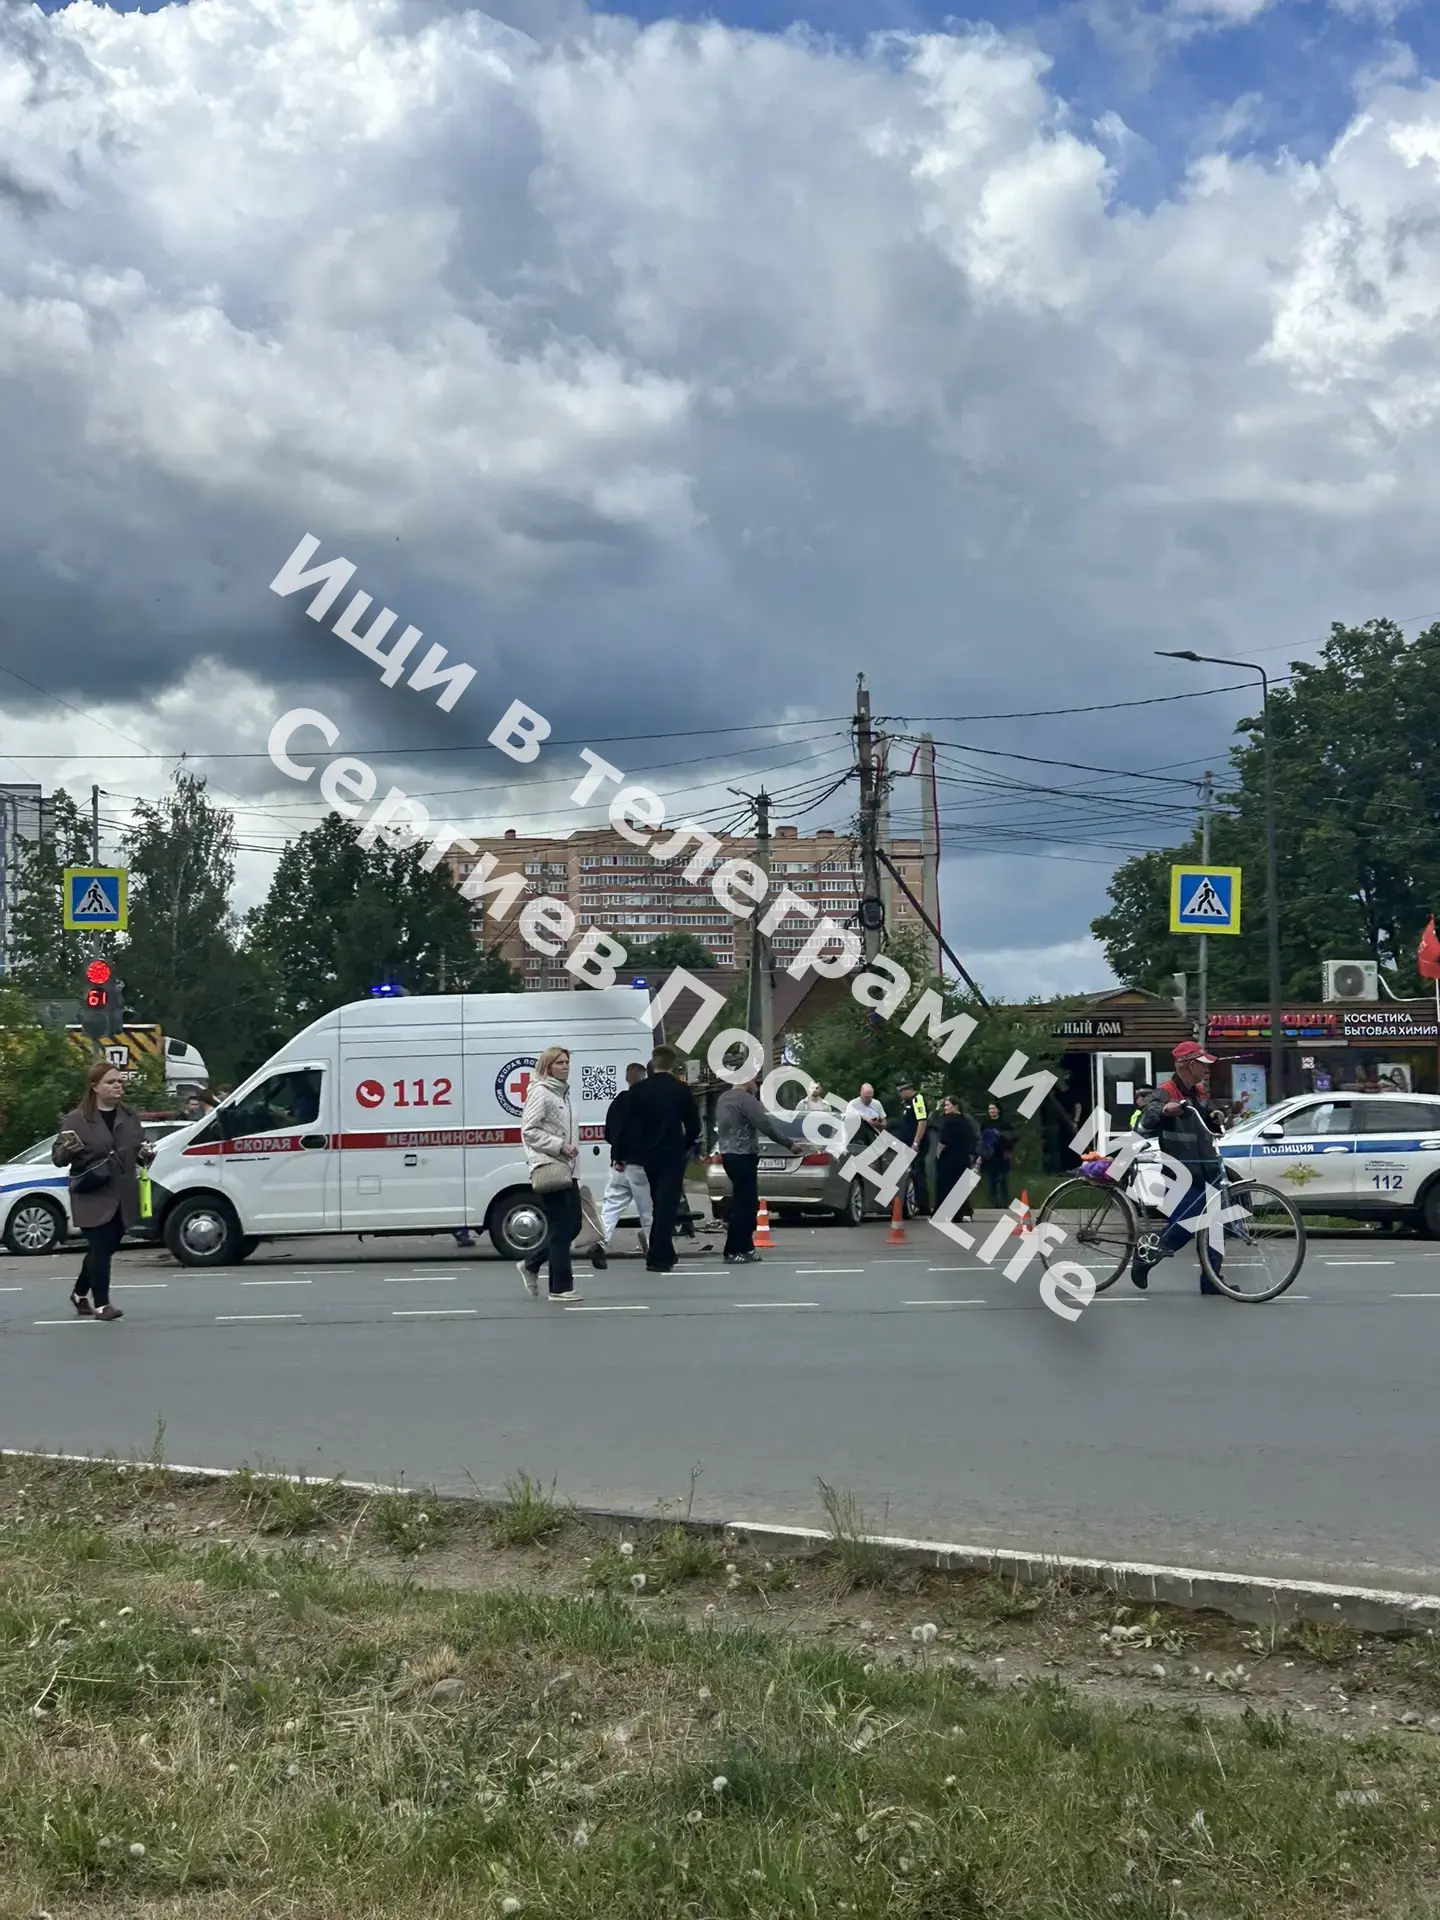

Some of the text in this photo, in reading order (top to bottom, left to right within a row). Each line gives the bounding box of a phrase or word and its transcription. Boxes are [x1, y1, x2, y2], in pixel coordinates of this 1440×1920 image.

[88, 990, 106, 1006] 61
[1344, 1013, 1412, 1023] КОСМЕТИКА
[1344, 1025, 1438, 1036] БЫТОВАЯ ХИМИЯ
[393, 1078, 453, 1107] 112
[233, 1138, 292, 1152] СКОРАЯ
[385, 1129, 505, 1147] МЕДИЦИНСКАЯ
[1262, 1143, 1314, 1155] ПОЛИЦИЯ
[1372, 1174, 1404, 1190] 112
